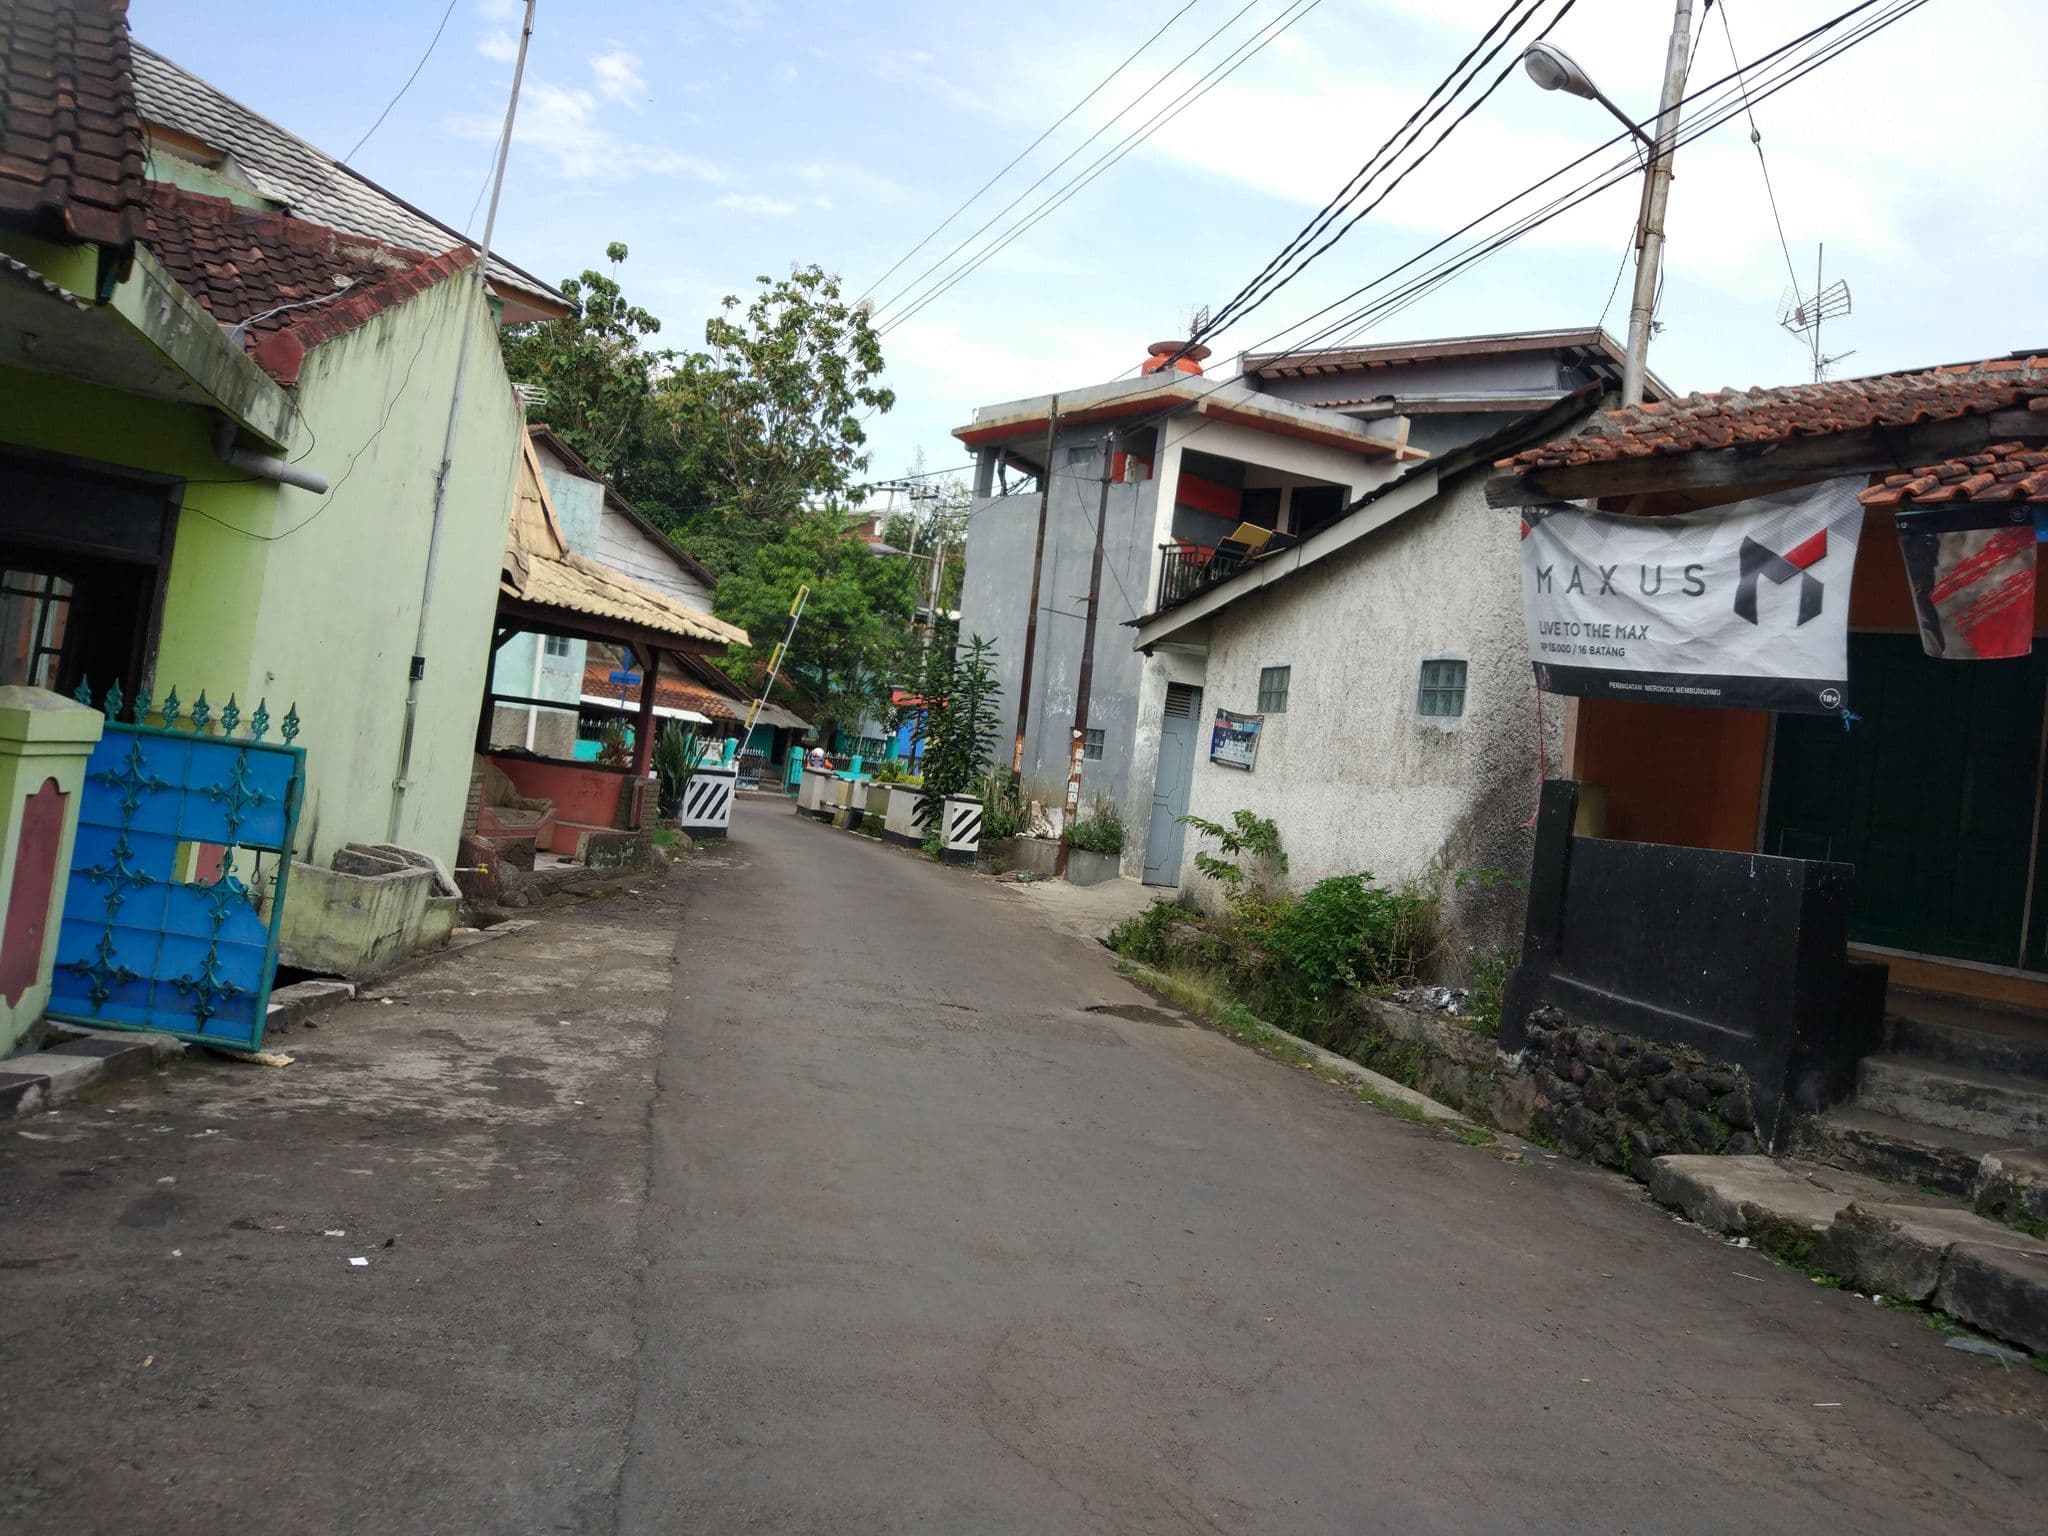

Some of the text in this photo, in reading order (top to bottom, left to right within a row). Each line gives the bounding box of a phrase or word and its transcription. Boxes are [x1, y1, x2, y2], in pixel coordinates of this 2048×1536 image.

[1536, 563, 1706, 597] MAXUS
[1539, 619, 1650, 641] LIVE TO THE MAX
[1578, 645, 1587, 656] 16
[1588, 646, 1626, 657] BATANG
